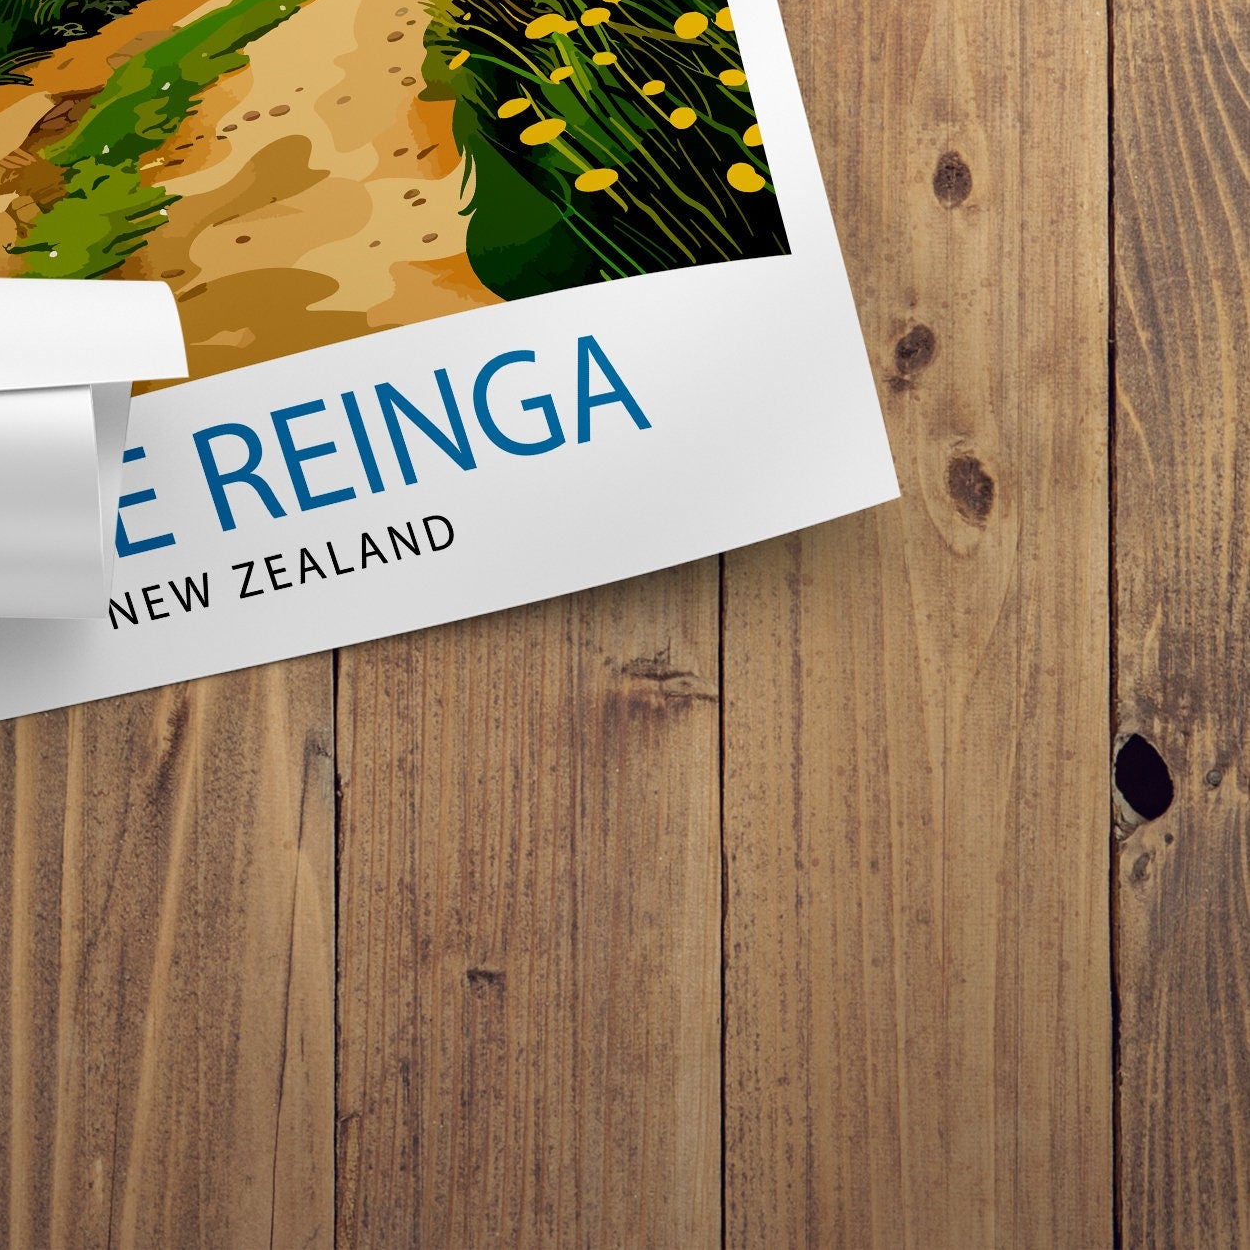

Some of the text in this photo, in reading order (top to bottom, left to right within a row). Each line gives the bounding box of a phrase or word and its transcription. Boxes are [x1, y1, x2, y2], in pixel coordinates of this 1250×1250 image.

[192, 334, 653, 532] REINGA
[108, 515, 455, 630] NEW ZEALAND
